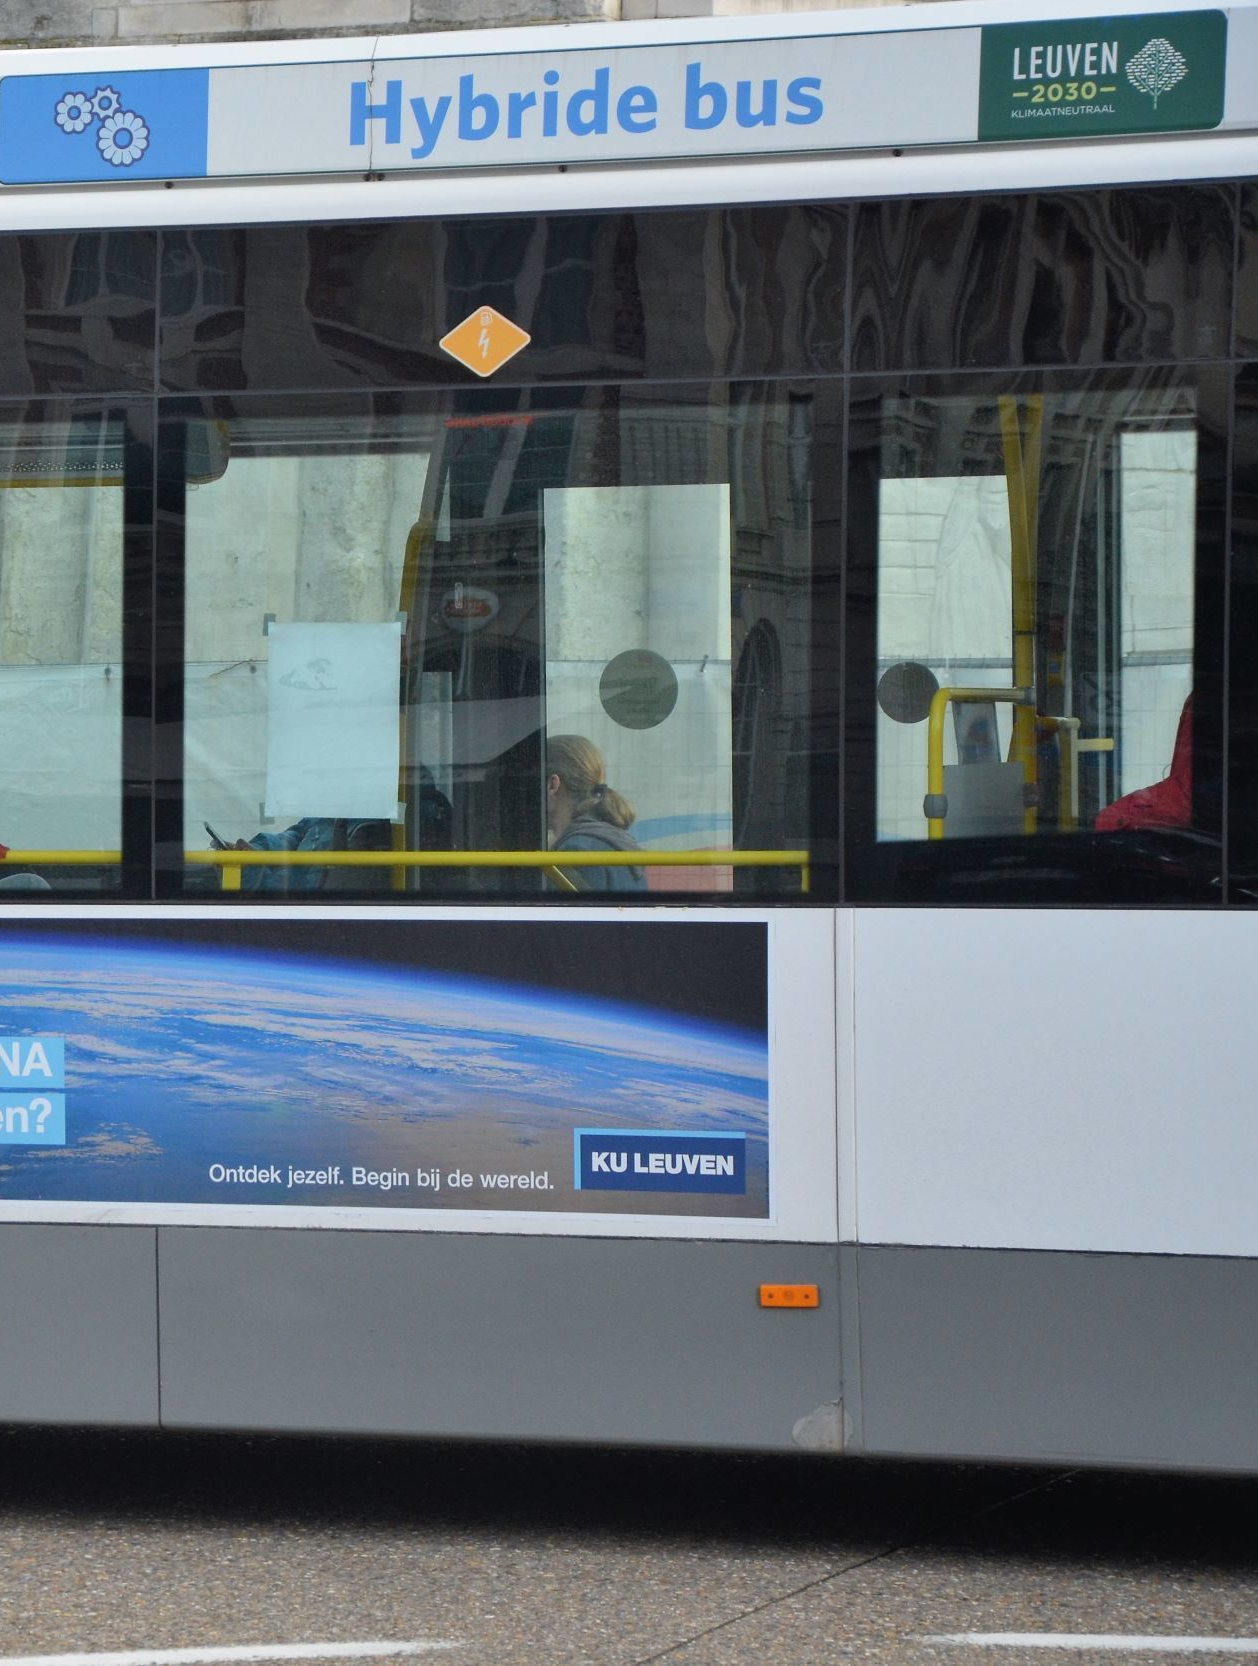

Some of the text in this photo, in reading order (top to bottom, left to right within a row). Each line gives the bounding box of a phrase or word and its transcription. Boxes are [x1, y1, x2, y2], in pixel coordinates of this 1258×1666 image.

[1012, 41, 1119, 80] LEUVEN
[349, 61, 824, 160] Hybride bus
[1011, 104, 1116, 119] KLIMAATNEUTRAAL
[208, 1163, 555, 1192] Ontdek jezelf. Begin bij de wereld.
[590, 1150, 735, 1177] KU LEUVEN
